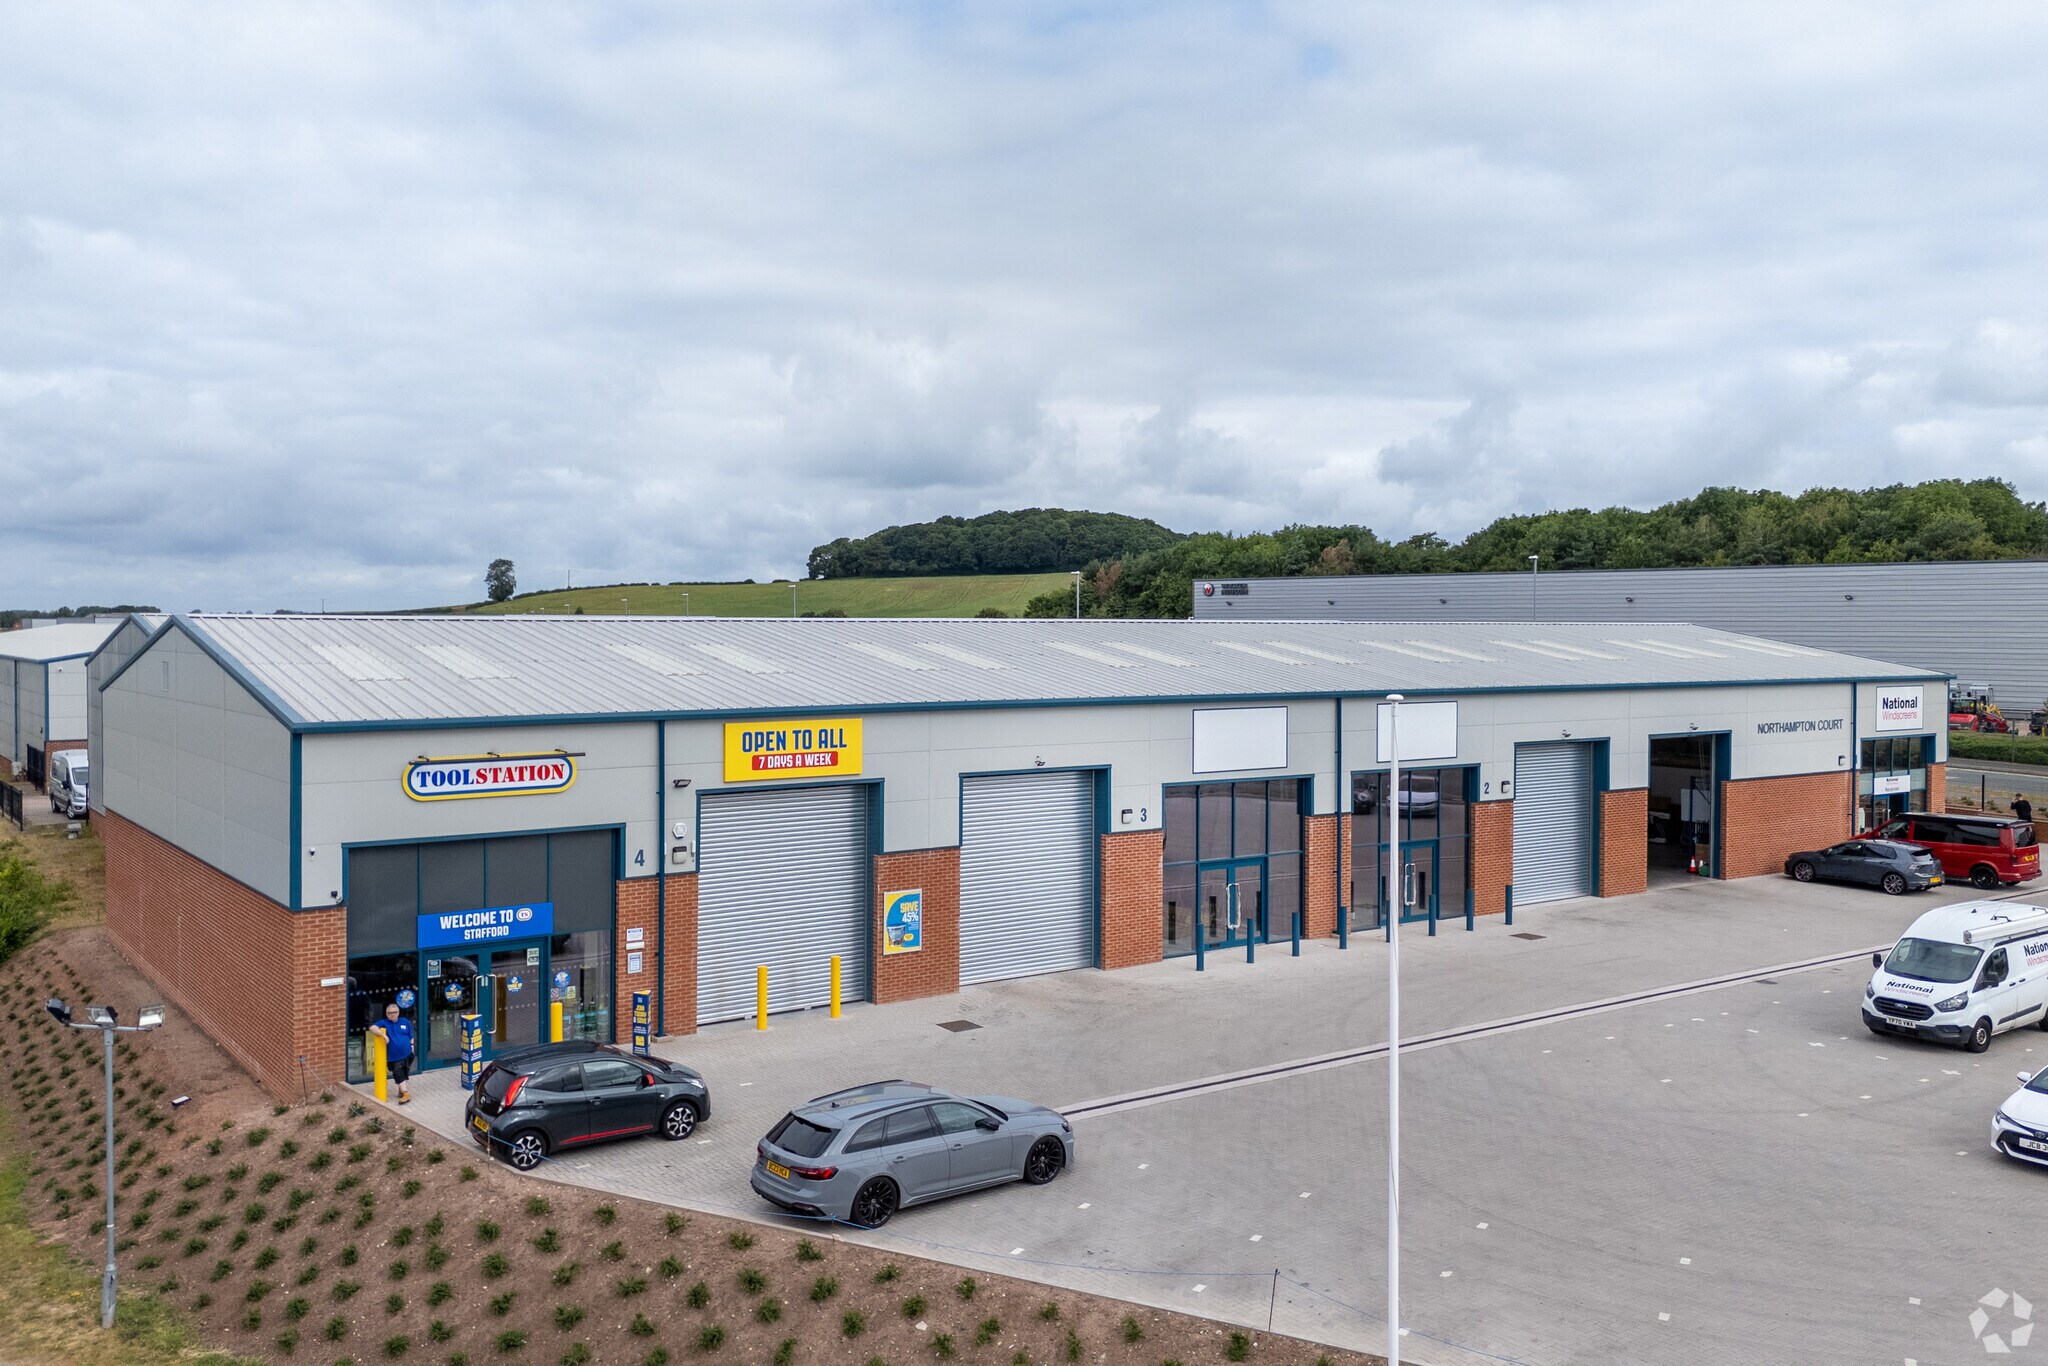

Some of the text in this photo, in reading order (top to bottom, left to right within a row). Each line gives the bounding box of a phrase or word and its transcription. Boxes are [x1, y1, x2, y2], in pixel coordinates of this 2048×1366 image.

[1882, 696, 1918, 710] National
[1882, 711, 1917, 720] Windscreens
[1757, 718, 1844, 734] NORTHAMPTON COURT
[742, 728, 847, 753] OPEN TO ALL
[759, 753, 832, 769] 7 DAYS A WEEK
[416, 764, 565, 788] TOOLSTATION
[1484, 782, 1490, 795] 2
[1140, 807, 1147, 822] 3
[634, 849, 645, 867] 4
[900, 901, 919, 913] SAVE
[440, 911, 497, 930] WELCOME
[499, 909, 514, 924] TO
[901, 911, 919, 923] 45%
[464, 925, 509, 940] STAFFORD
[1886, 980, 1934, 994] National
[2027, 1141, 2041, 1150] JCB
